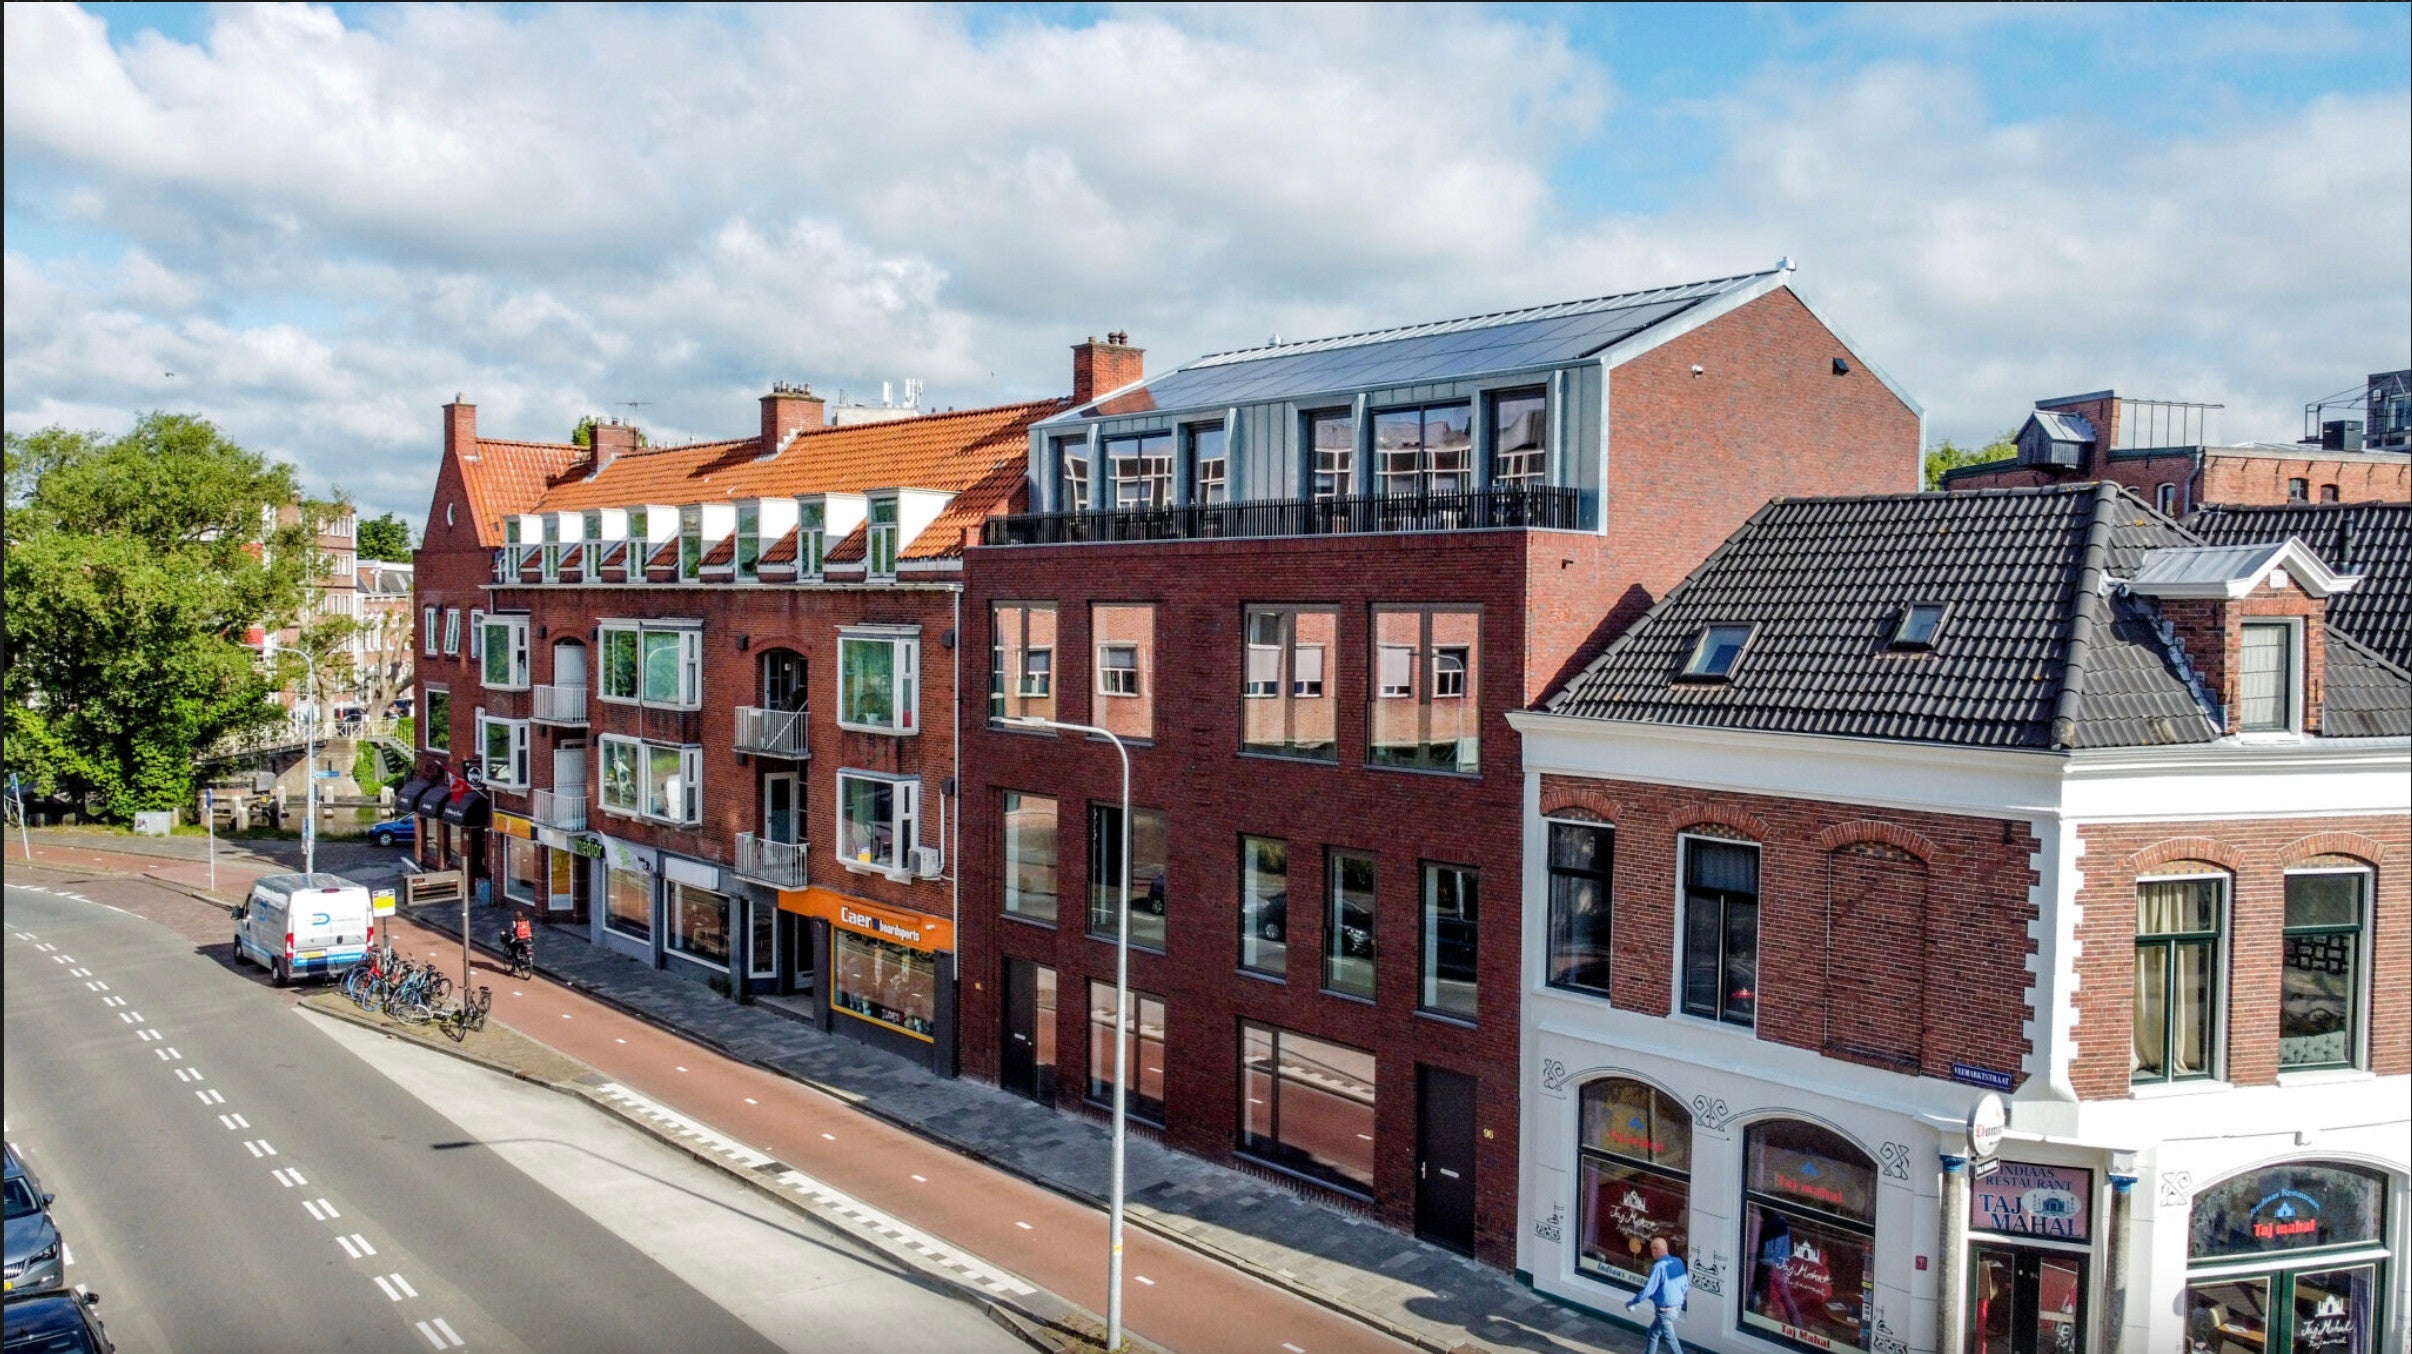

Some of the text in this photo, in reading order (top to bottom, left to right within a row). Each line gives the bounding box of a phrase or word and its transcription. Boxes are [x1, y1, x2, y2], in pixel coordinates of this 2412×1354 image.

[841, 906, 872, 928] Caer
[1954, 1066, 2010, 1086] VEEMARKTSTRAAT
[2000, 1164, 2055, 1178] INDIAAS
[1778, 1174, 1797, 1192] Taj
[1985, 1176, 2074, 1191] RESTAURANT
[1978, 1194, 2022, 1215] TAJ
[1991, 1213, 2083, 1236] MAHAL
[2253, 1218, 2317, 1239] Taj mahal
[1781, 1323, 1830, 1349] Taj Mahal
